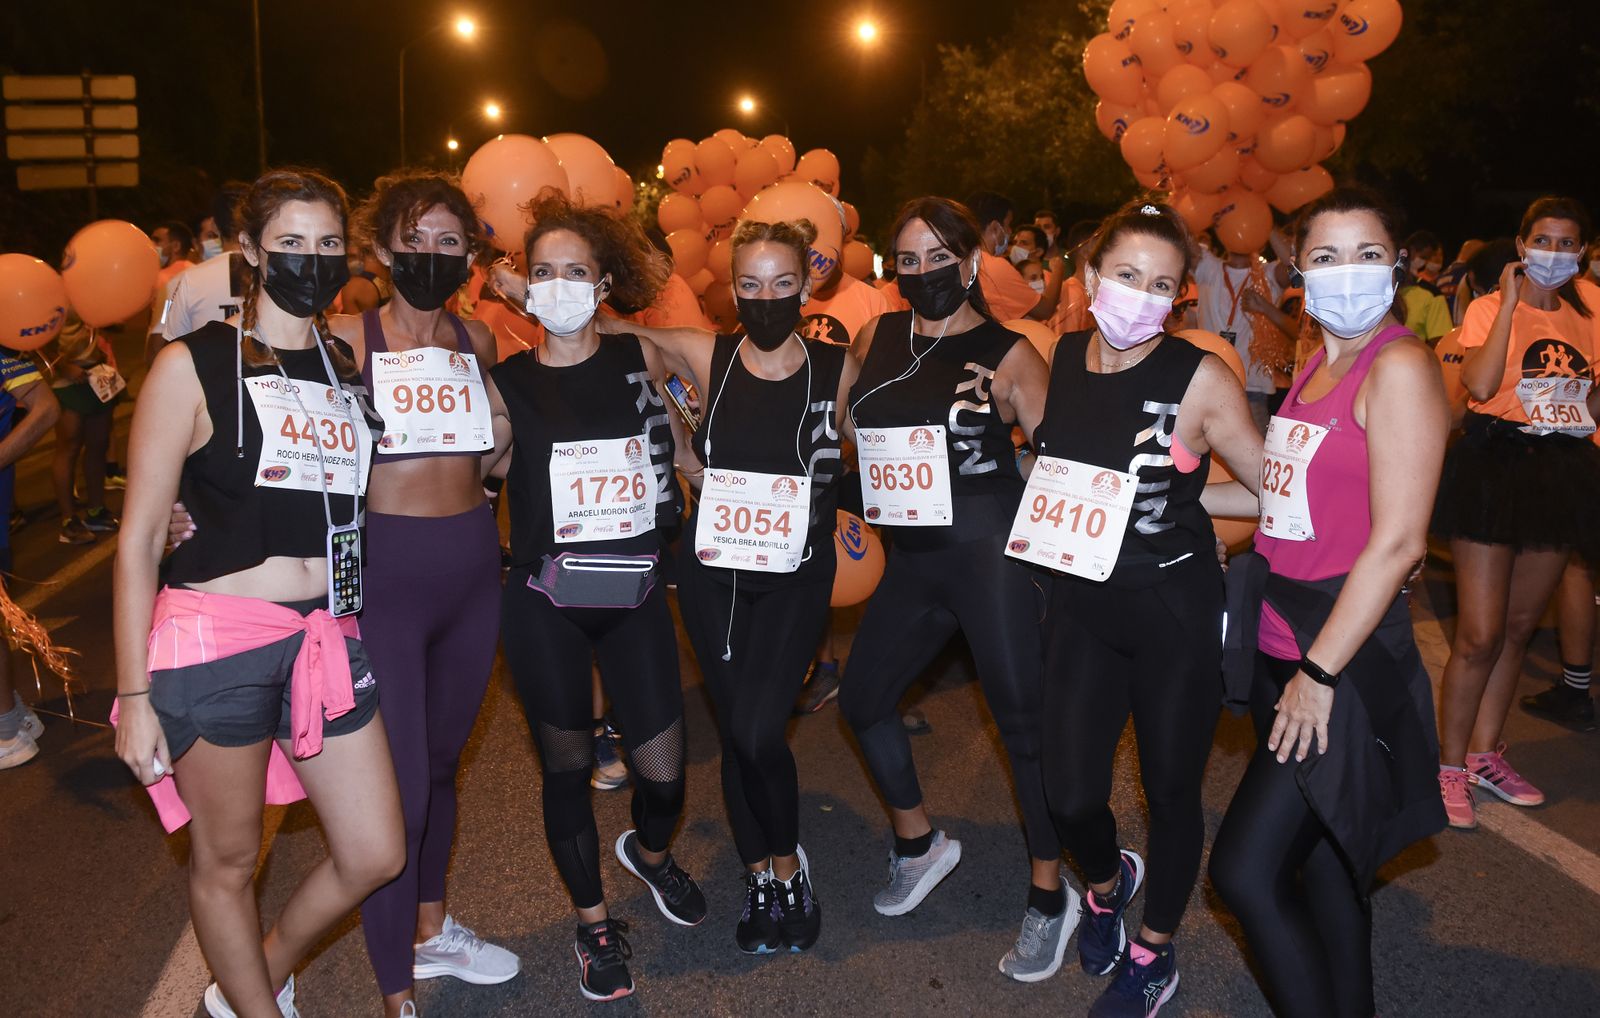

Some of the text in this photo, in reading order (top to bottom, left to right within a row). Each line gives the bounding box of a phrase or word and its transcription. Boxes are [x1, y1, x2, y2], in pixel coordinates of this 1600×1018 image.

[393, 384, 472, 413] 9861
[1531, 404, 1582, 423] 4350
[280, 414, 356, 453] 4430
[276, 449, 300, 460] ROCIO
[570, 472, 646, 505] 1726
[869, 462, 933, 491] 9630
[568, 510, 600, 518] ARACELI
[713, 504, 792, 538] 3054
[1029, 494, 1107, 538] 9410
[713, 536, 737, 545] YESICA
[758, 542, 790, 550] MORILLO
